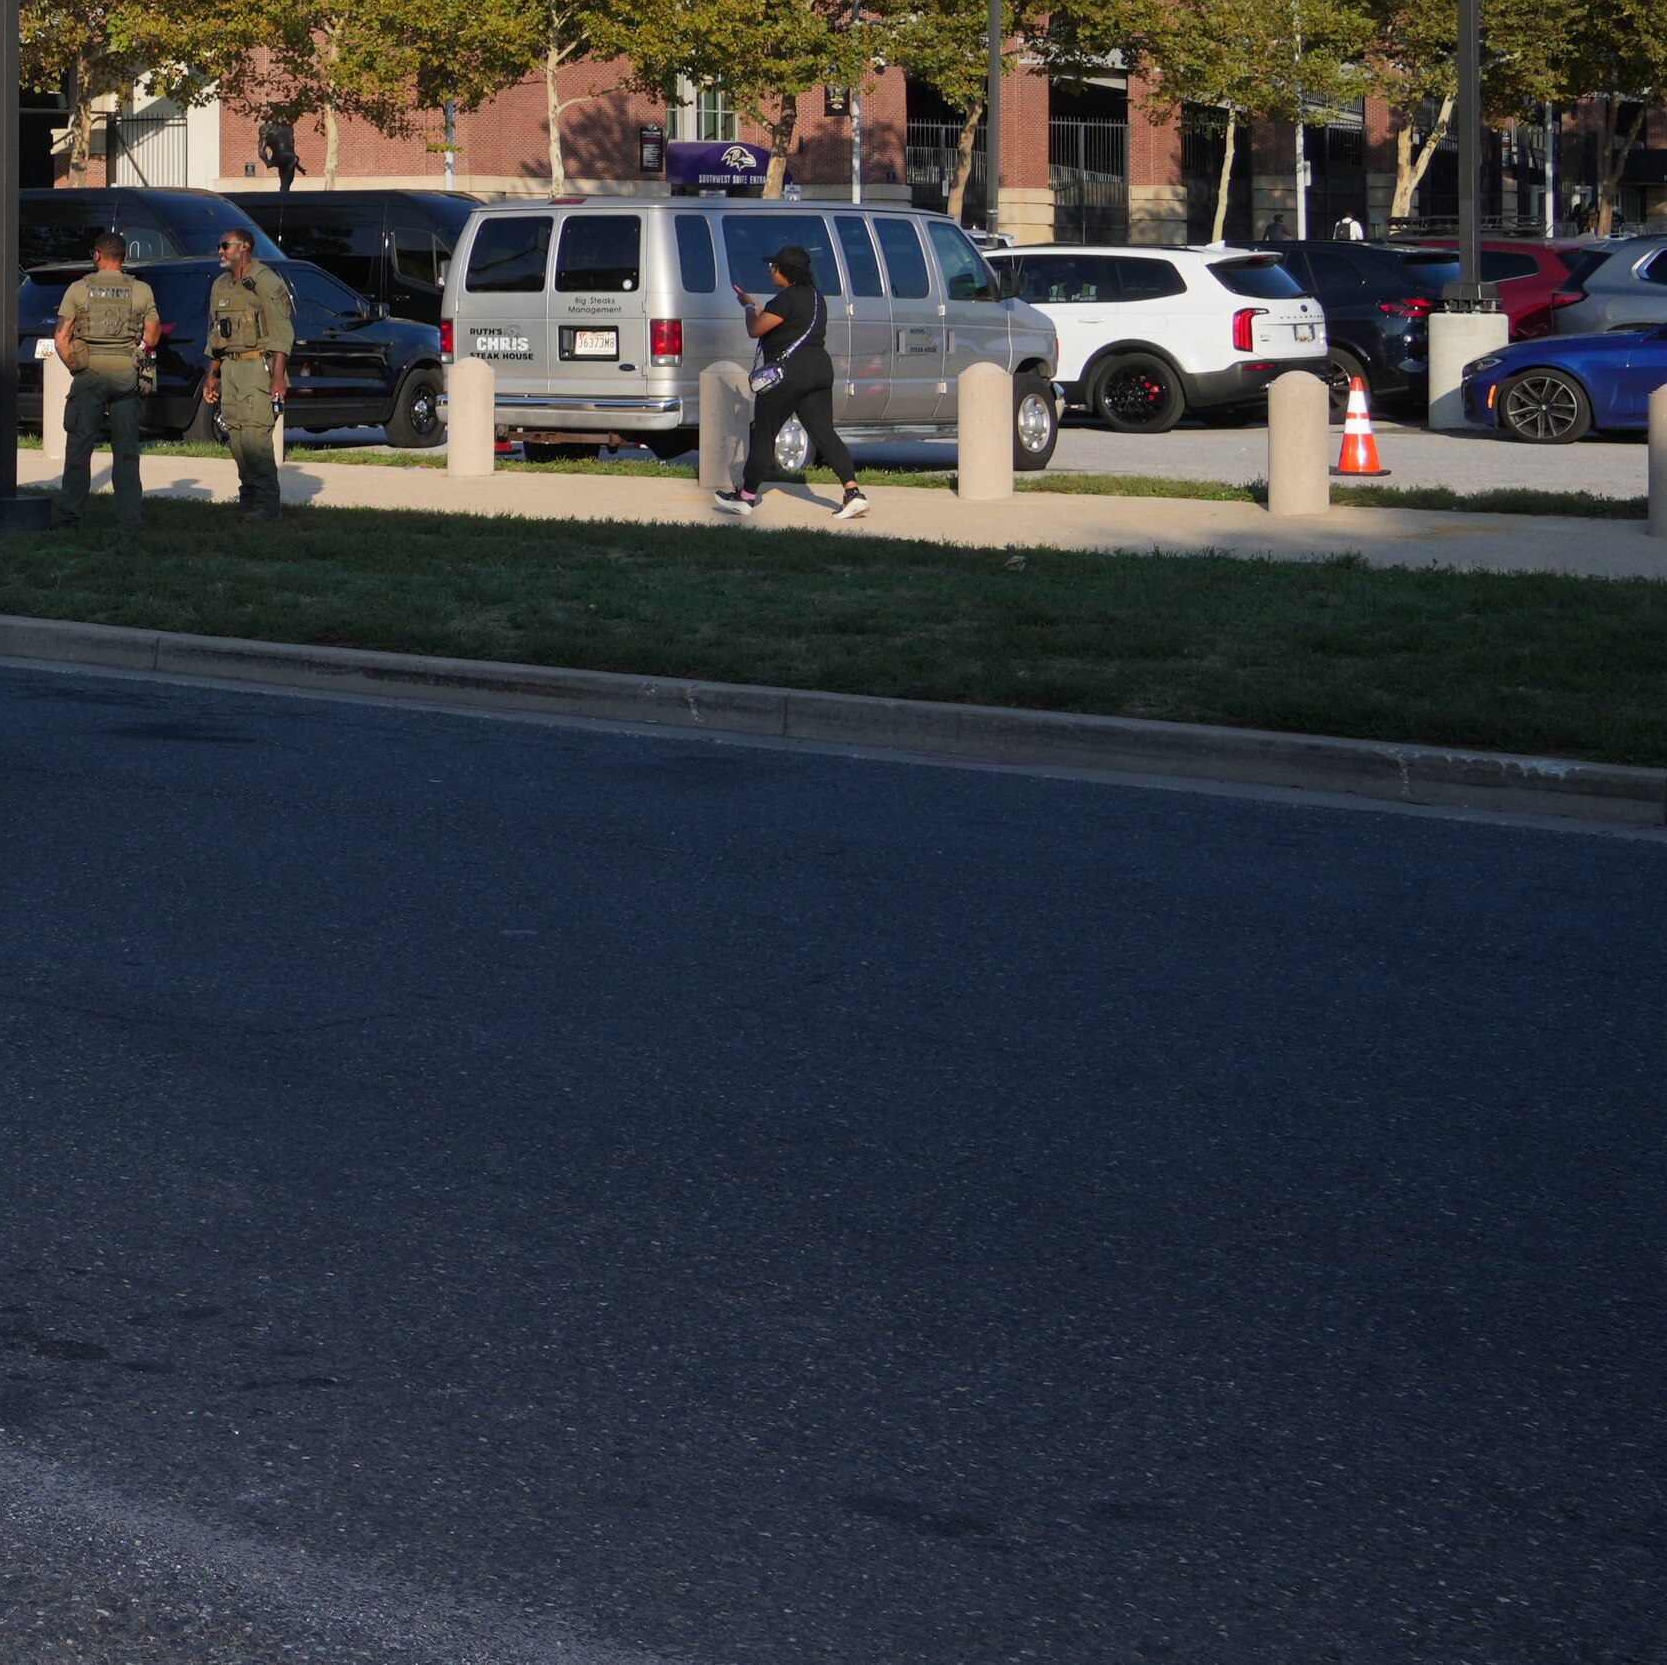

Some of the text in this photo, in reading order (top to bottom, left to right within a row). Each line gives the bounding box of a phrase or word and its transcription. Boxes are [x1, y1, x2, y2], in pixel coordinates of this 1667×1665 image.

[698, 174, 766, 185] SOUTHWEST SUITE ENTRA
[575, 297, 586, 306] Big
[568, 306, 622, 314] Management
[476, 337, 529, 351] CHRIS
[470, 352, 534, 361] STEAK HOUSE
